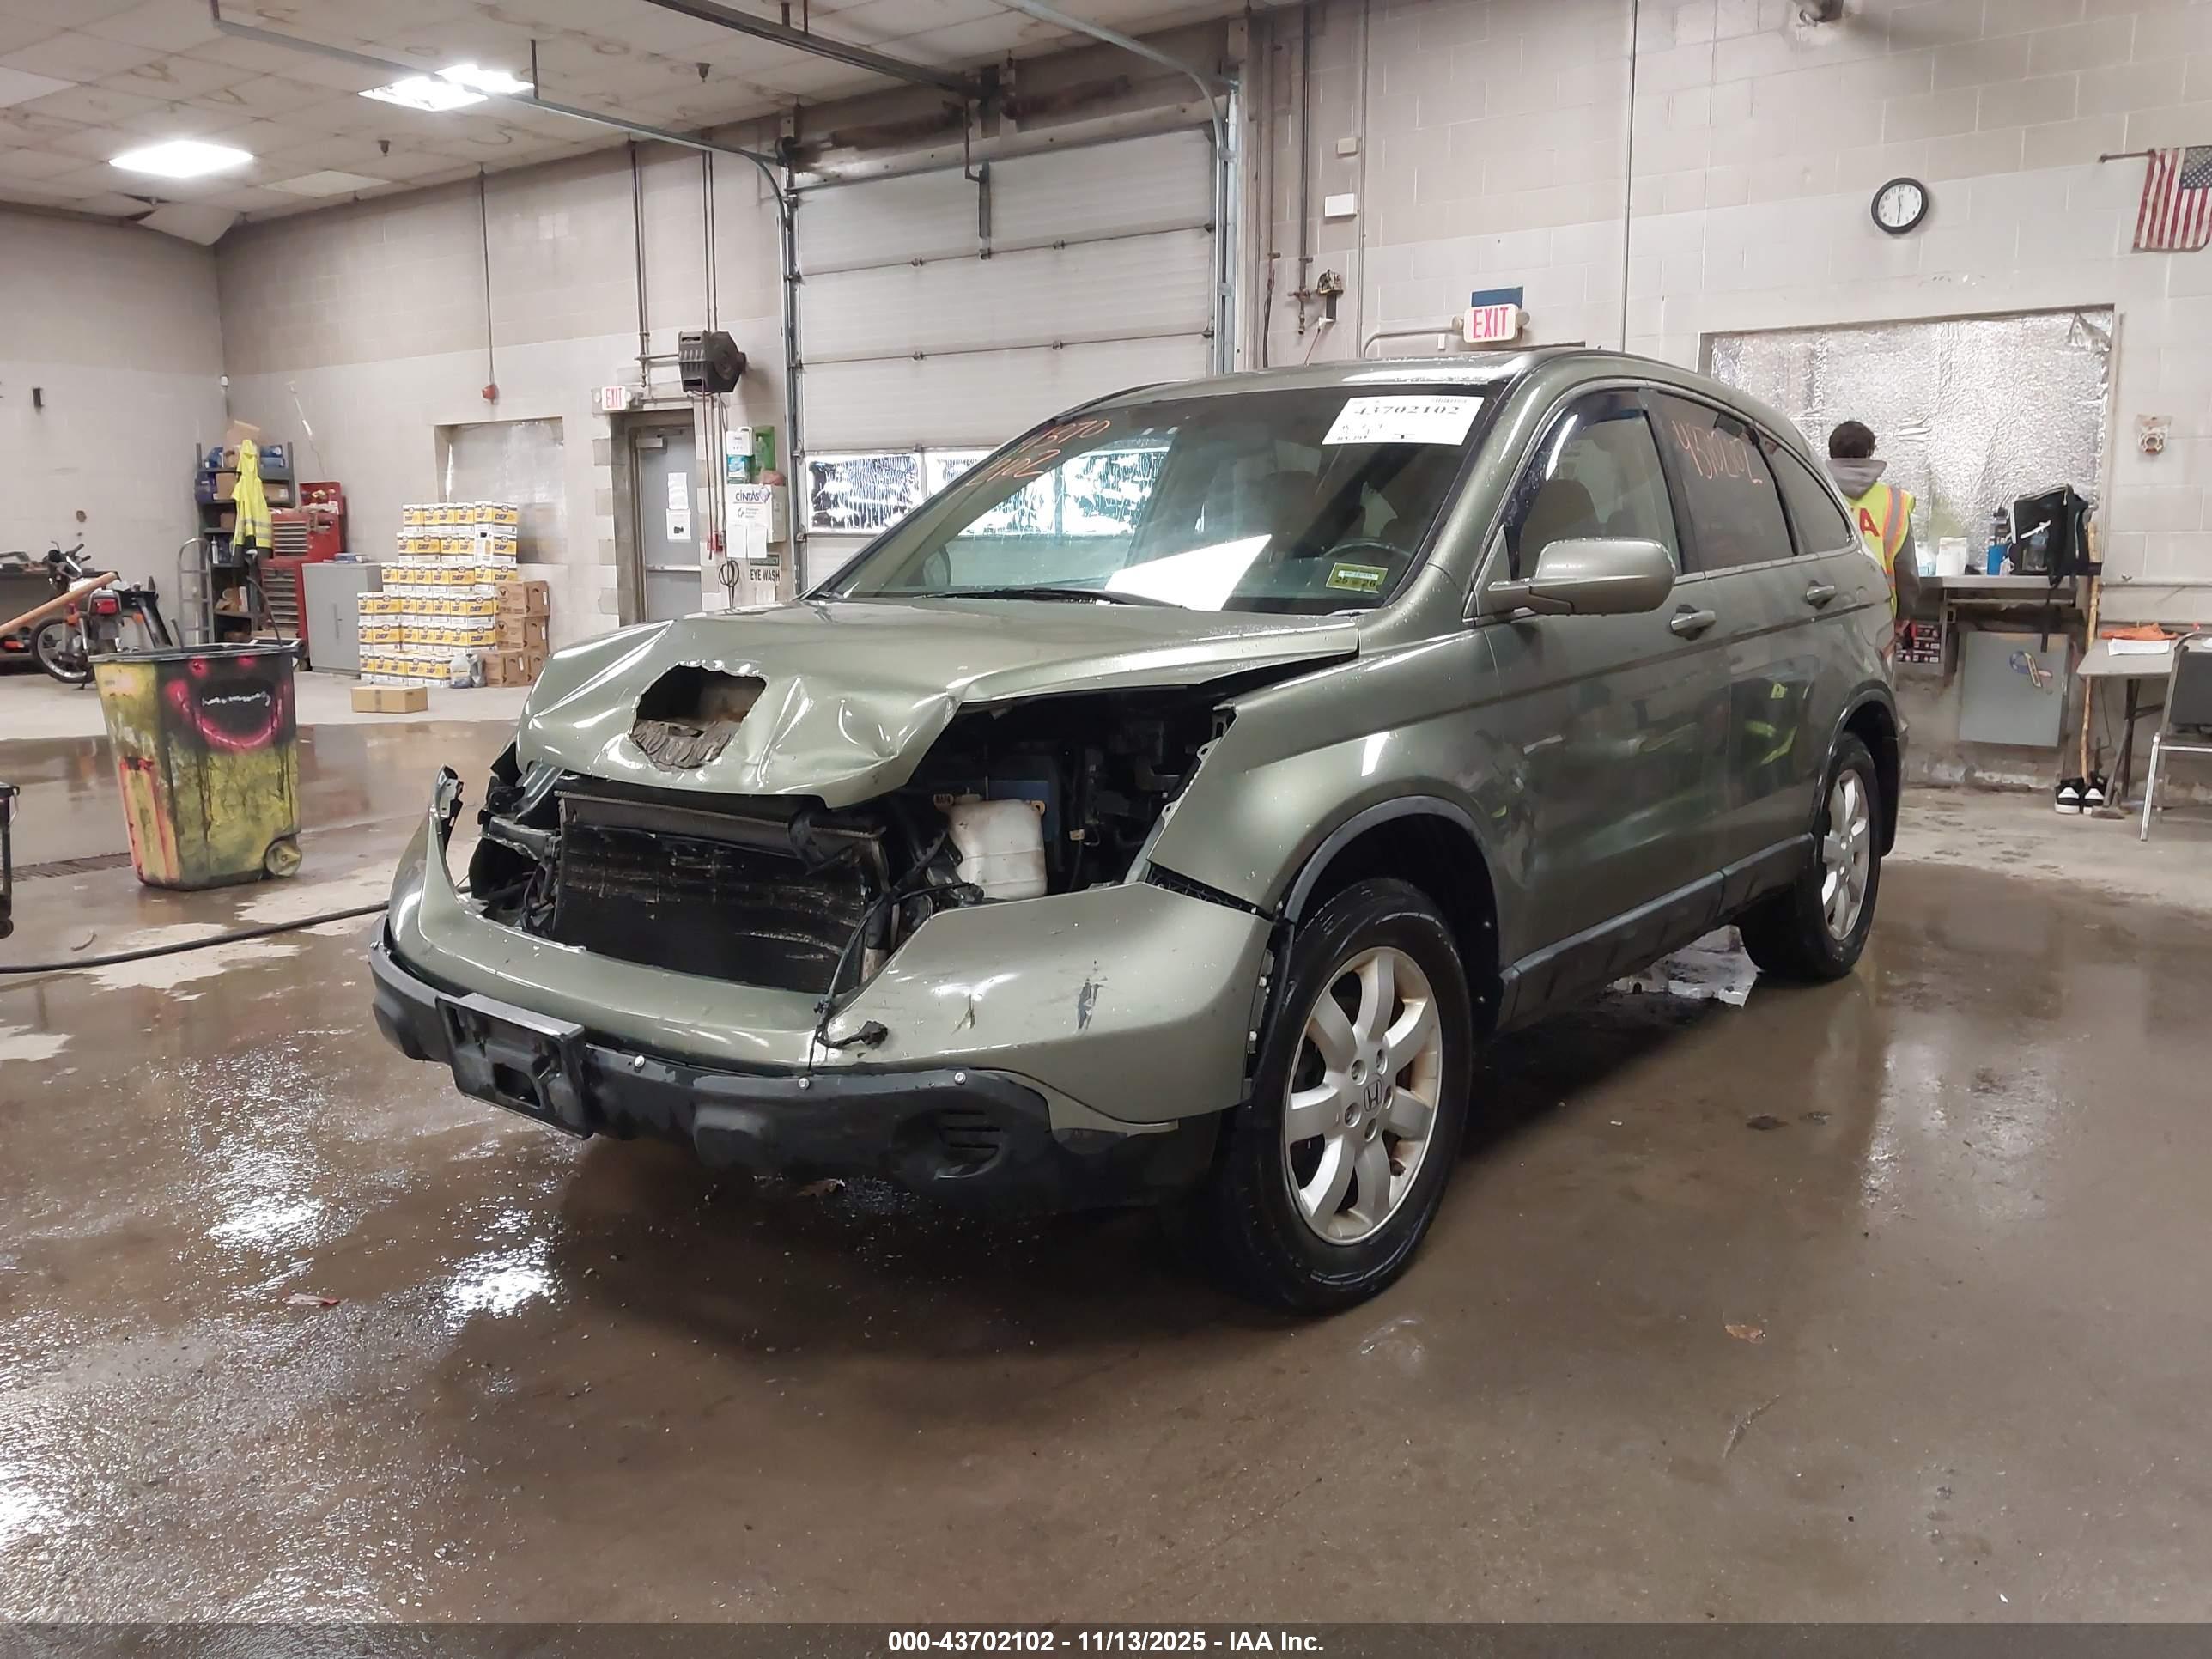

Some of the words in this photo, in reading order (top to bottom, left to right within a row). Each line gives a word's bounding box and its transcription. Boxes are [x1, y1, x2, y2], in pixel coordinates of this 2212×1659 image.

[1474, 307, 1509, 338] EXIT
[606, 388, 622, 408] EXIT
[1850, 507, 1880, 537] A
[750, 569, 761, 580] EYE
[763, 569, 780, 581] WASH
